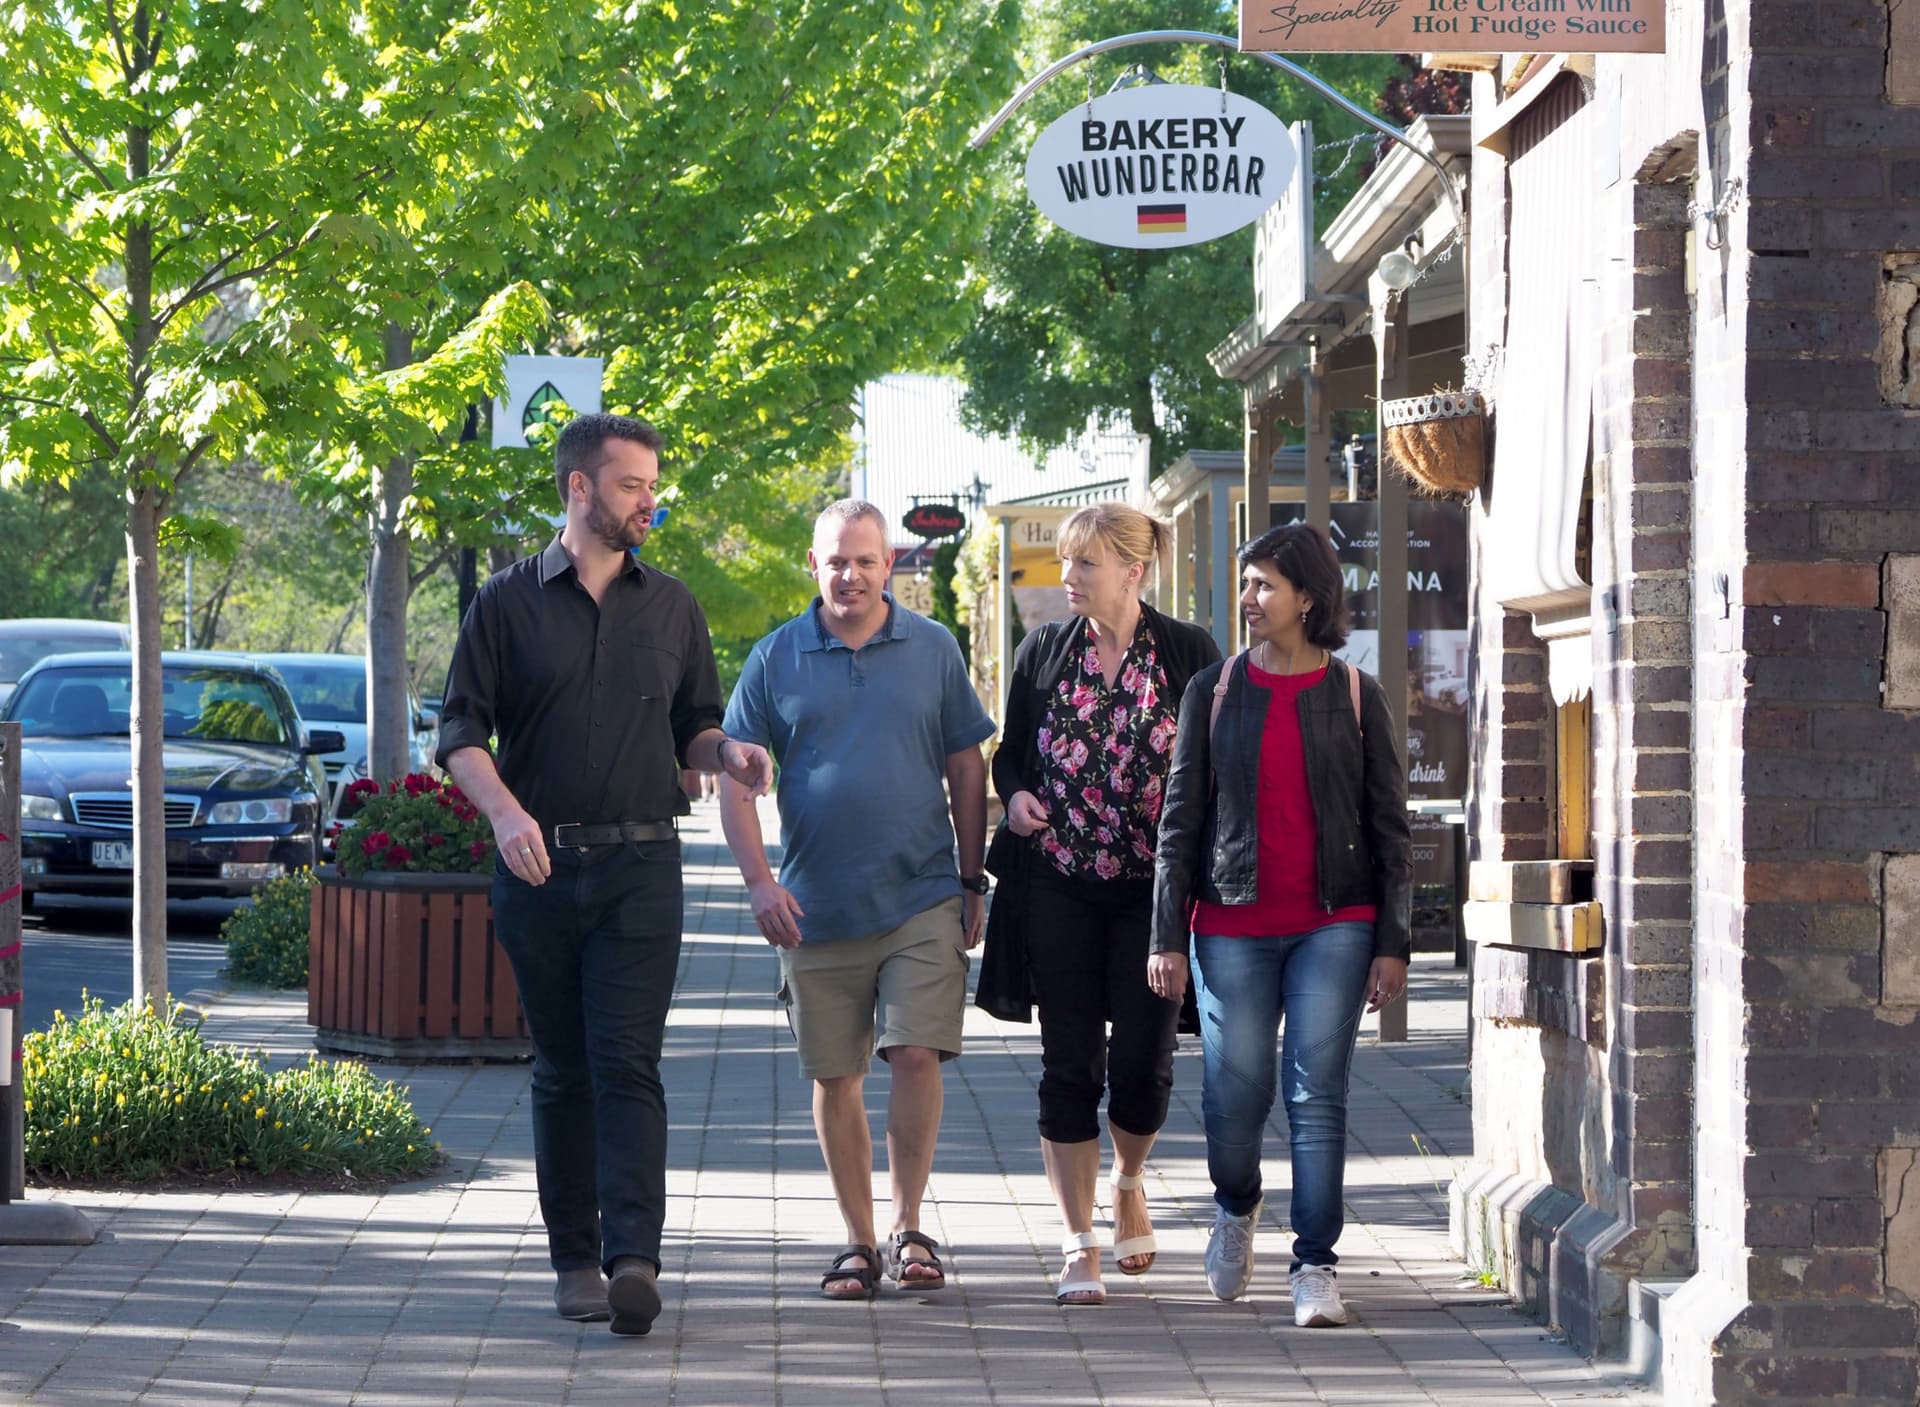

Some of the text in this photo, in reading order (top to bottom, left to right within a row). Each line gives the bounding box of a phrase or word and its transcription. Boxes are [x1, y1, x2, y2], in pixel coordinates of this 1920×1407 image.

[1258, 0, 1401, 41] Specialty
[1428, 0, 1467, 12] Ice
[1477, 0, 1565, 12] Cream
[1412, 15, 1648, 41] Hot Fudge Sauce
[1082, 116, 1247, 151] BAKERY
[1056, 152, 1266, 203] WUNDERBAR
[1408, 760, 1447, 783] drink
